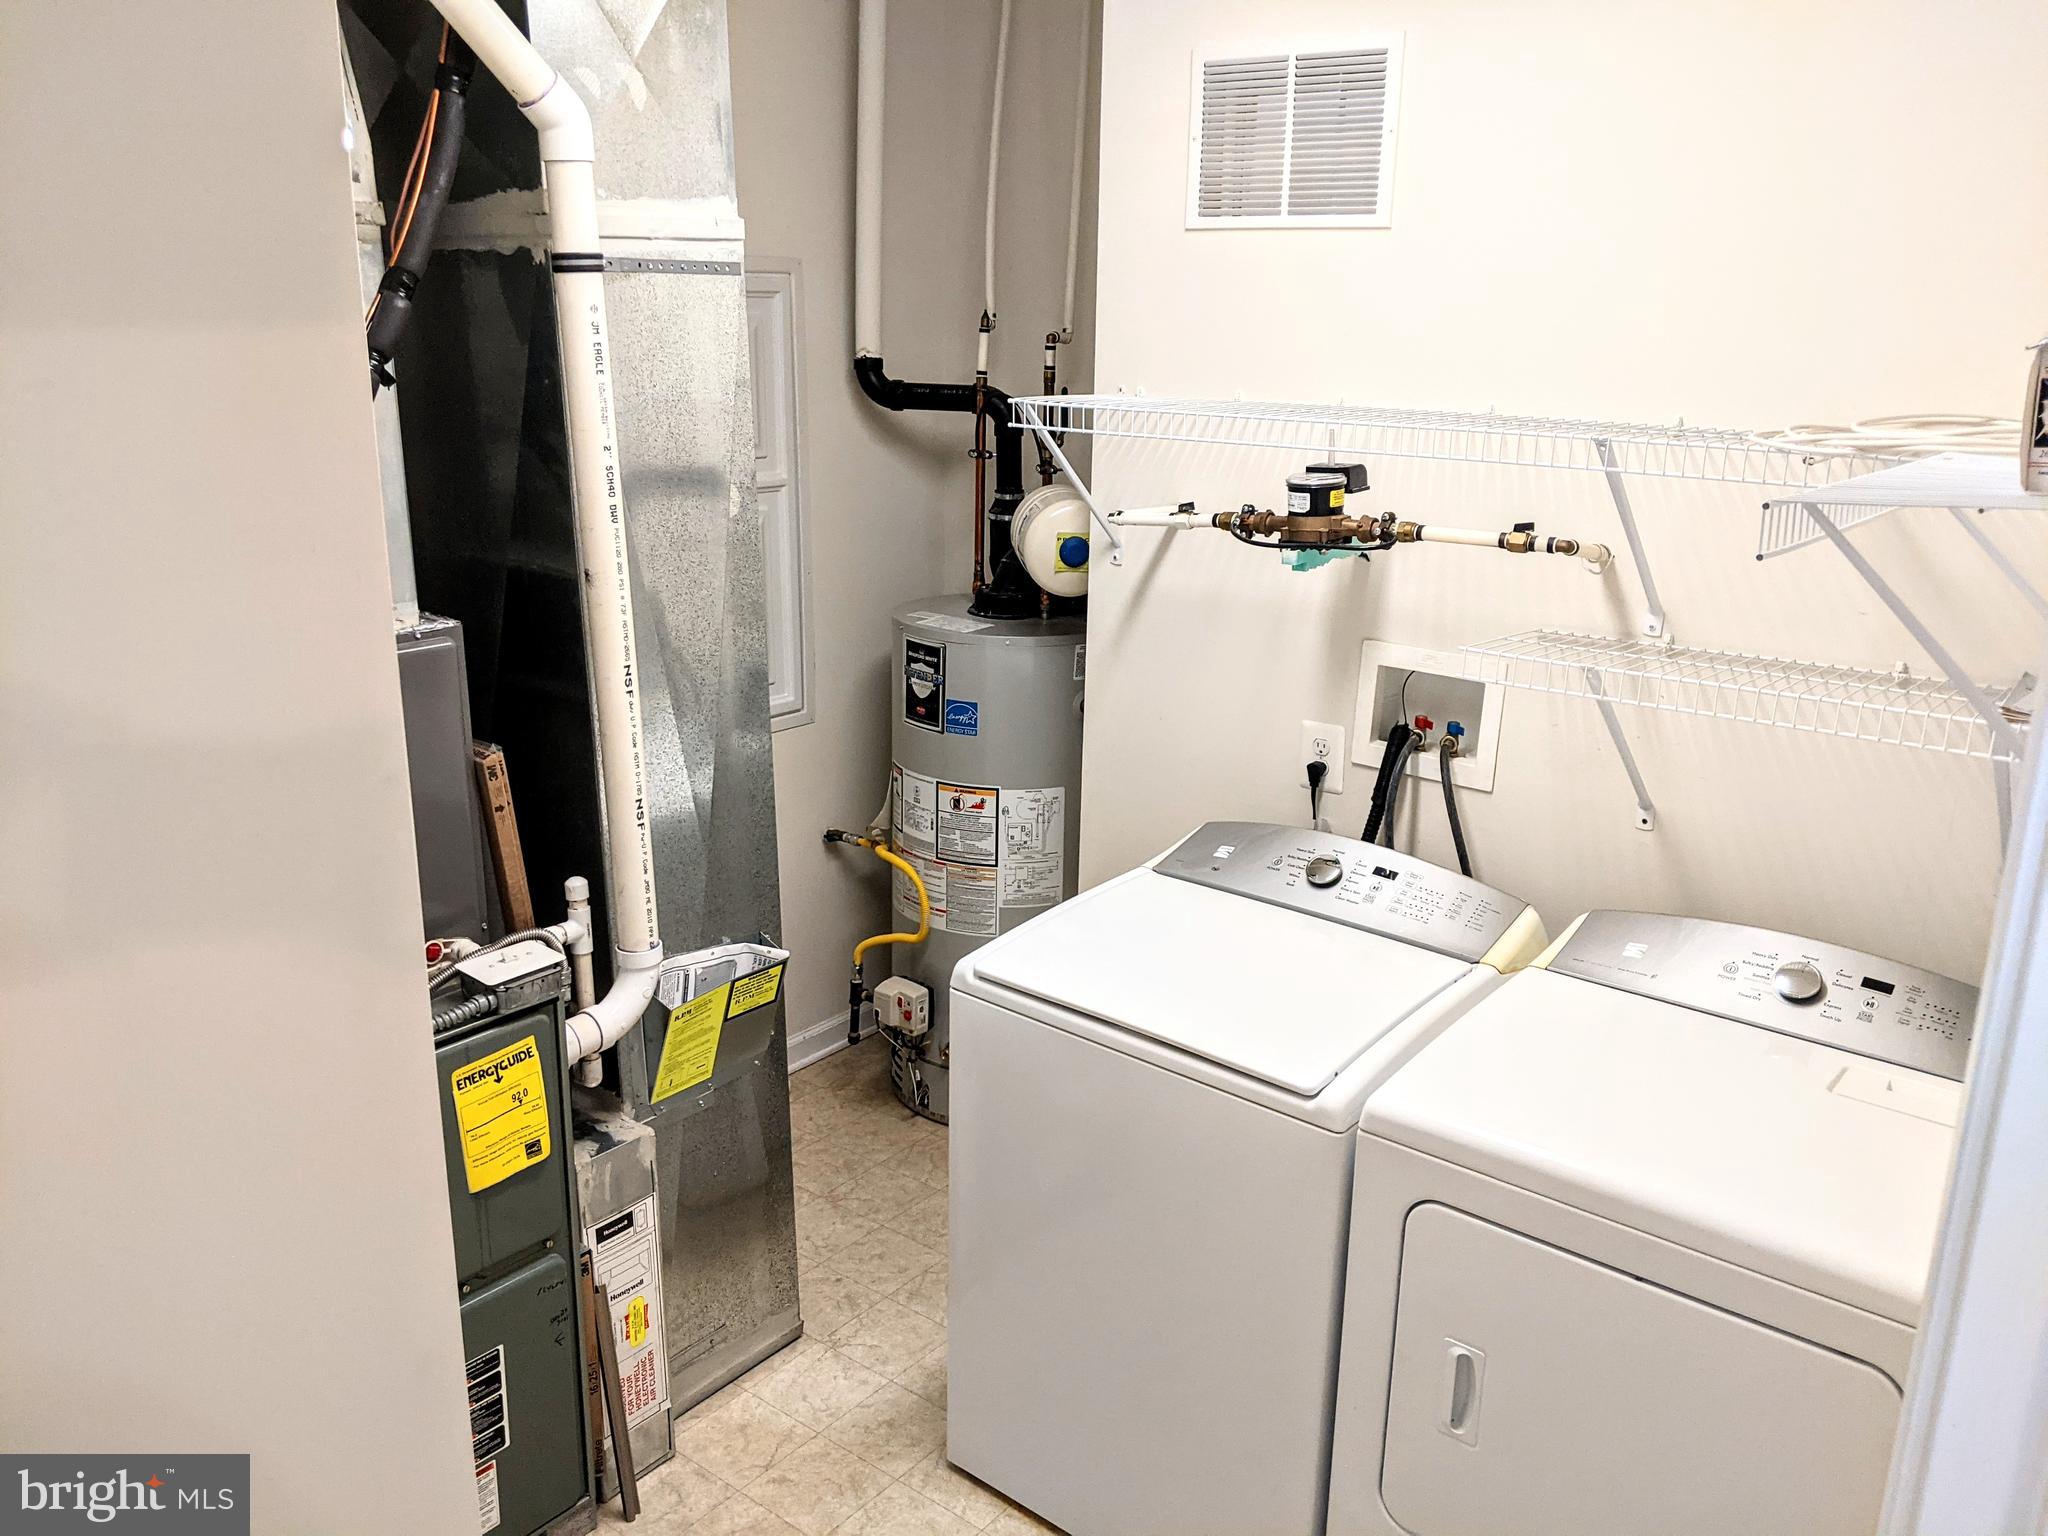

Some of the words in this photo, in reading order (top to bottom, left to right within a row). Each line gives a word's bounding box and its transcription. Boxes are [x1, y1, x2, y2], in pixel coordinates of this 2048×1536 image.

[591, 321, 600, 335] JM
[593, 342, 604, 375] EAGLE
[605, 465, 616, 498] SCH40
[609, 504, 618, 524] DWV
[623, 664, 634, 699] NSF
[635, 798, 645, 831] NSF
[456, 1046, 535, 1091] ENERGYGUIDE
[511, 1087, 529, 1103] 92.0
[603, 1220, 628, 1236] Honeywell
[580, 1261, 590, 1277] 3M
[610, 1279, 644, 1302] Honeywell
[640, 1356, 650, 1407] ELECTRONIC
[647, 1349, 657, 1387] CLEANER
[626, 1374, 634, 1397] YOUR
[633, 1360, 643, 1412] HONEYWELL
[627, 1396, 636, 1416] FOR
